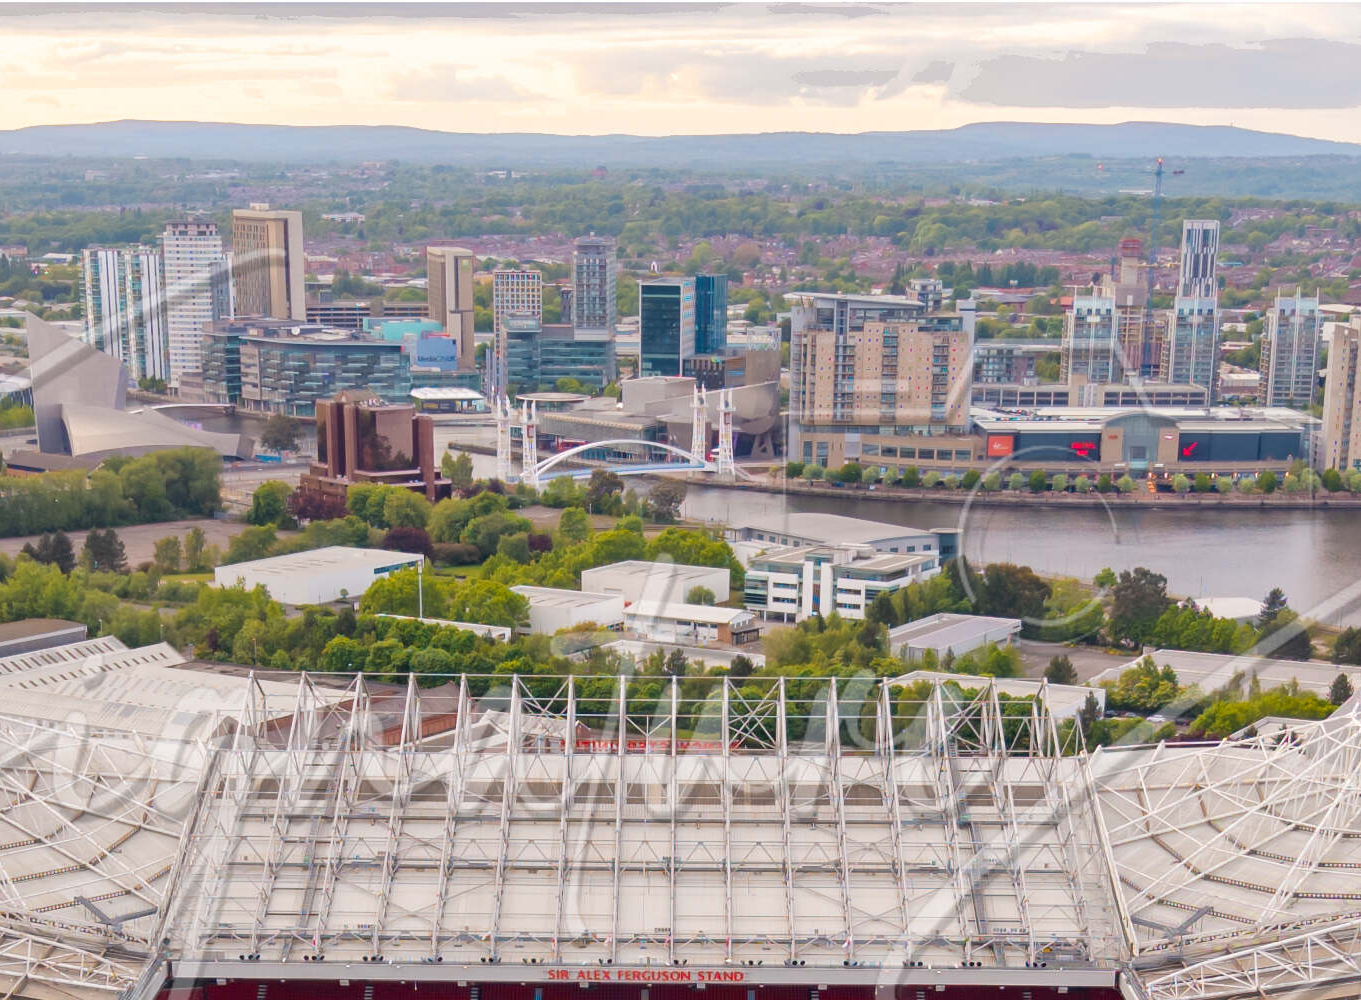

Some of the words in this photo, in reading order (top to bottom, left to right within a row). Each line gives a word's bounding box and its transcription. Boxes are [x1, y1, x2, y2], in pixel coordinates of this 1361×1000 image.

[548, 969, 569, 980] SIR
[577, 969, 610, 980] ALEX
[618, 970, 690, 981] FERGUSON
[697, 971, 744, 982] STAND
